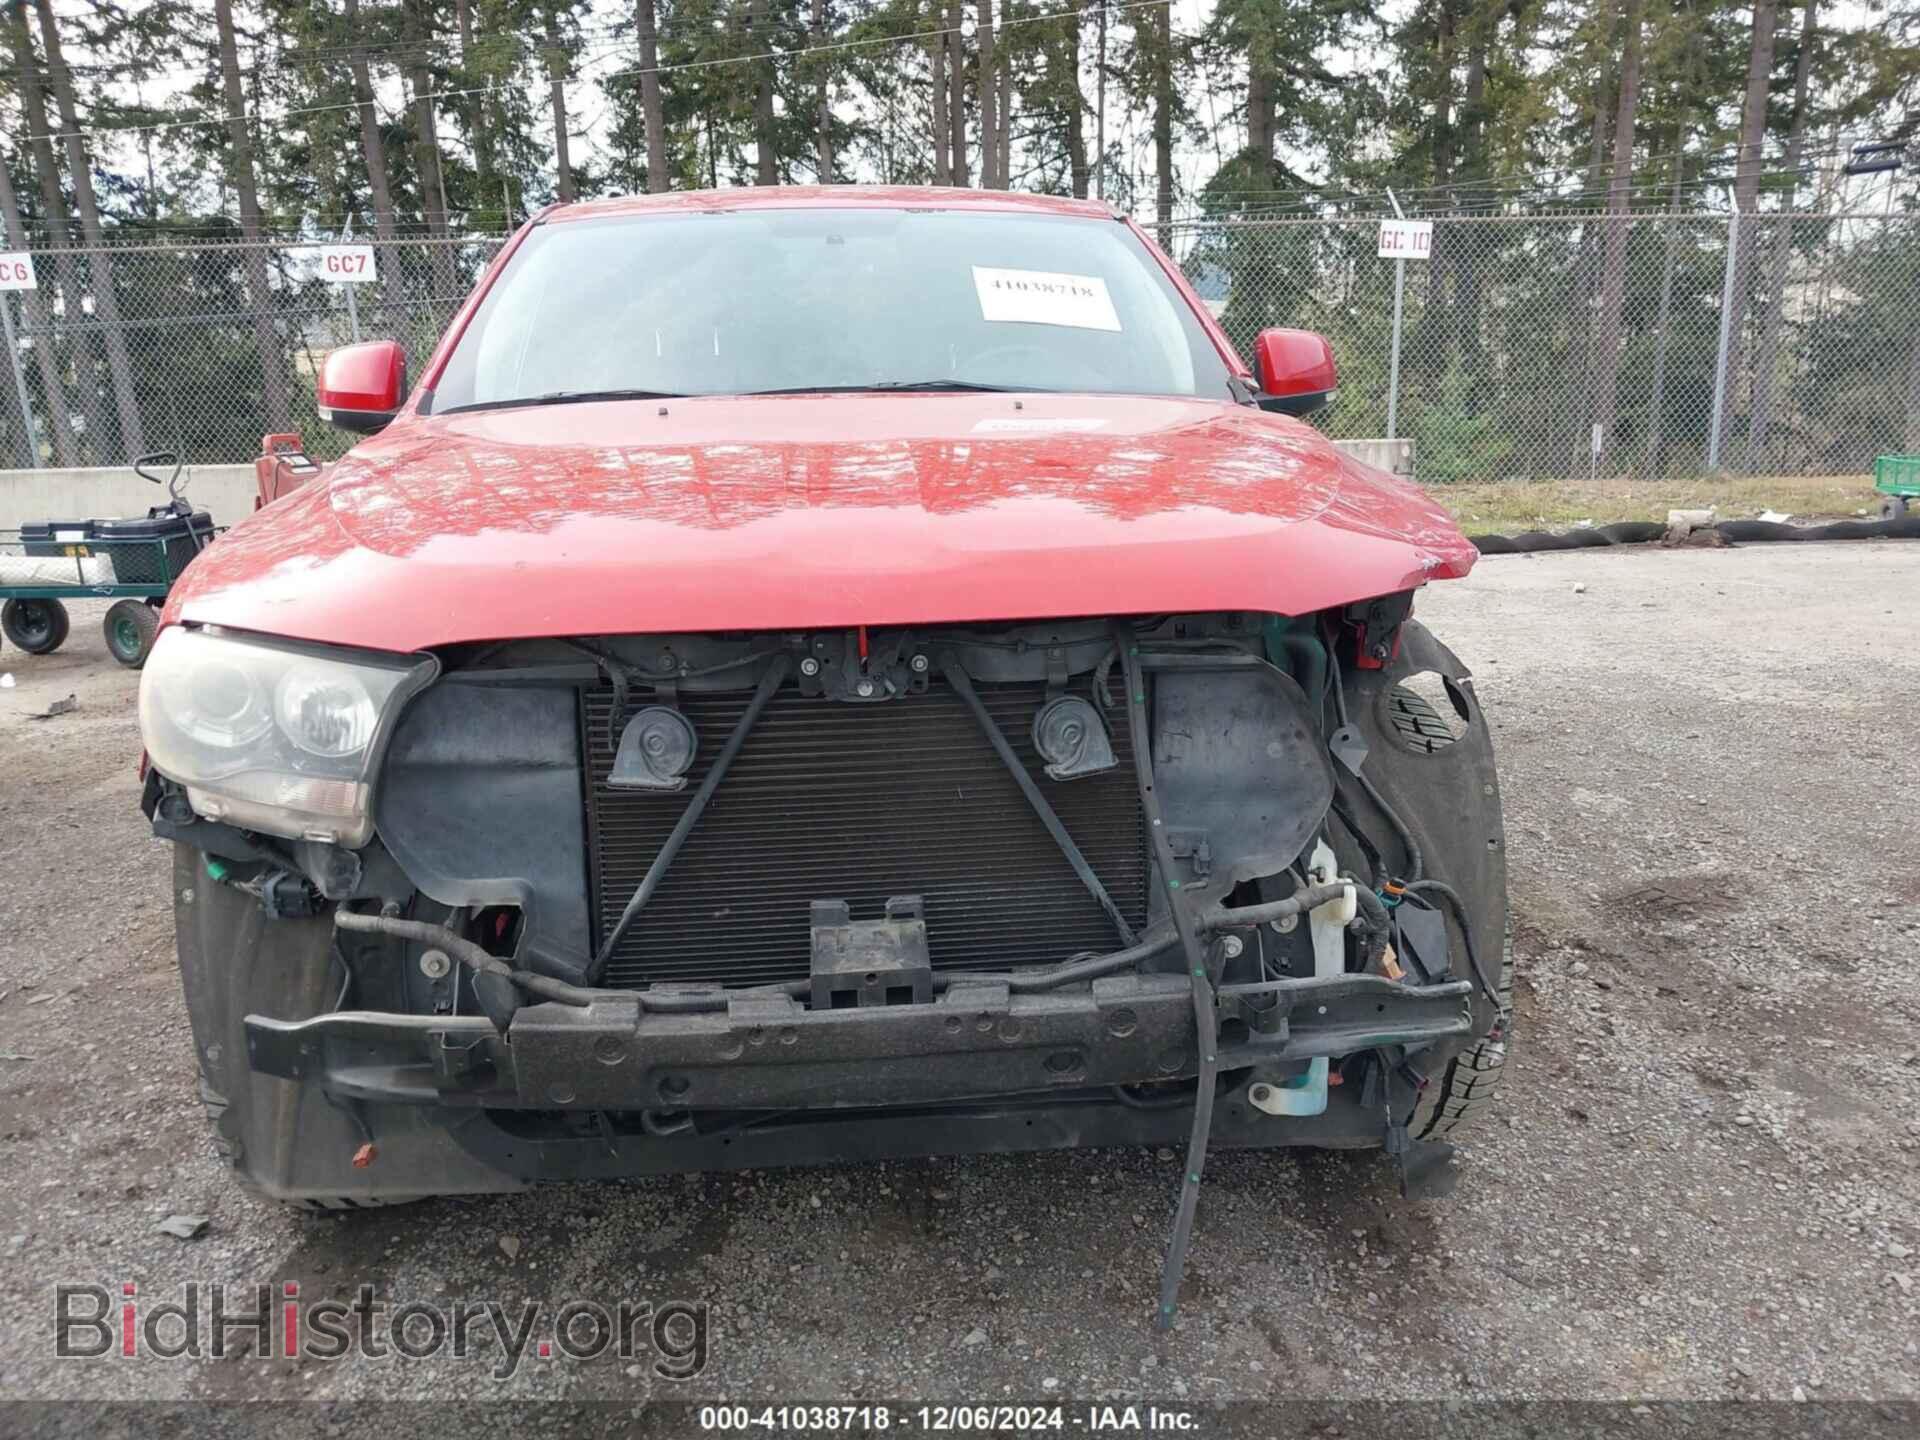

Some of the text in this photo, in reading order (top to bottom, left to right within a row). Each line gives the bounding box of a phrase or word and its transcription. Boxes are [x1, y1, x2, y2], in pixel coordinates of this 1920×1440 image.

[1381, 230, 1431, 250] GC 10
[327, 254, 366, 273] GC7
